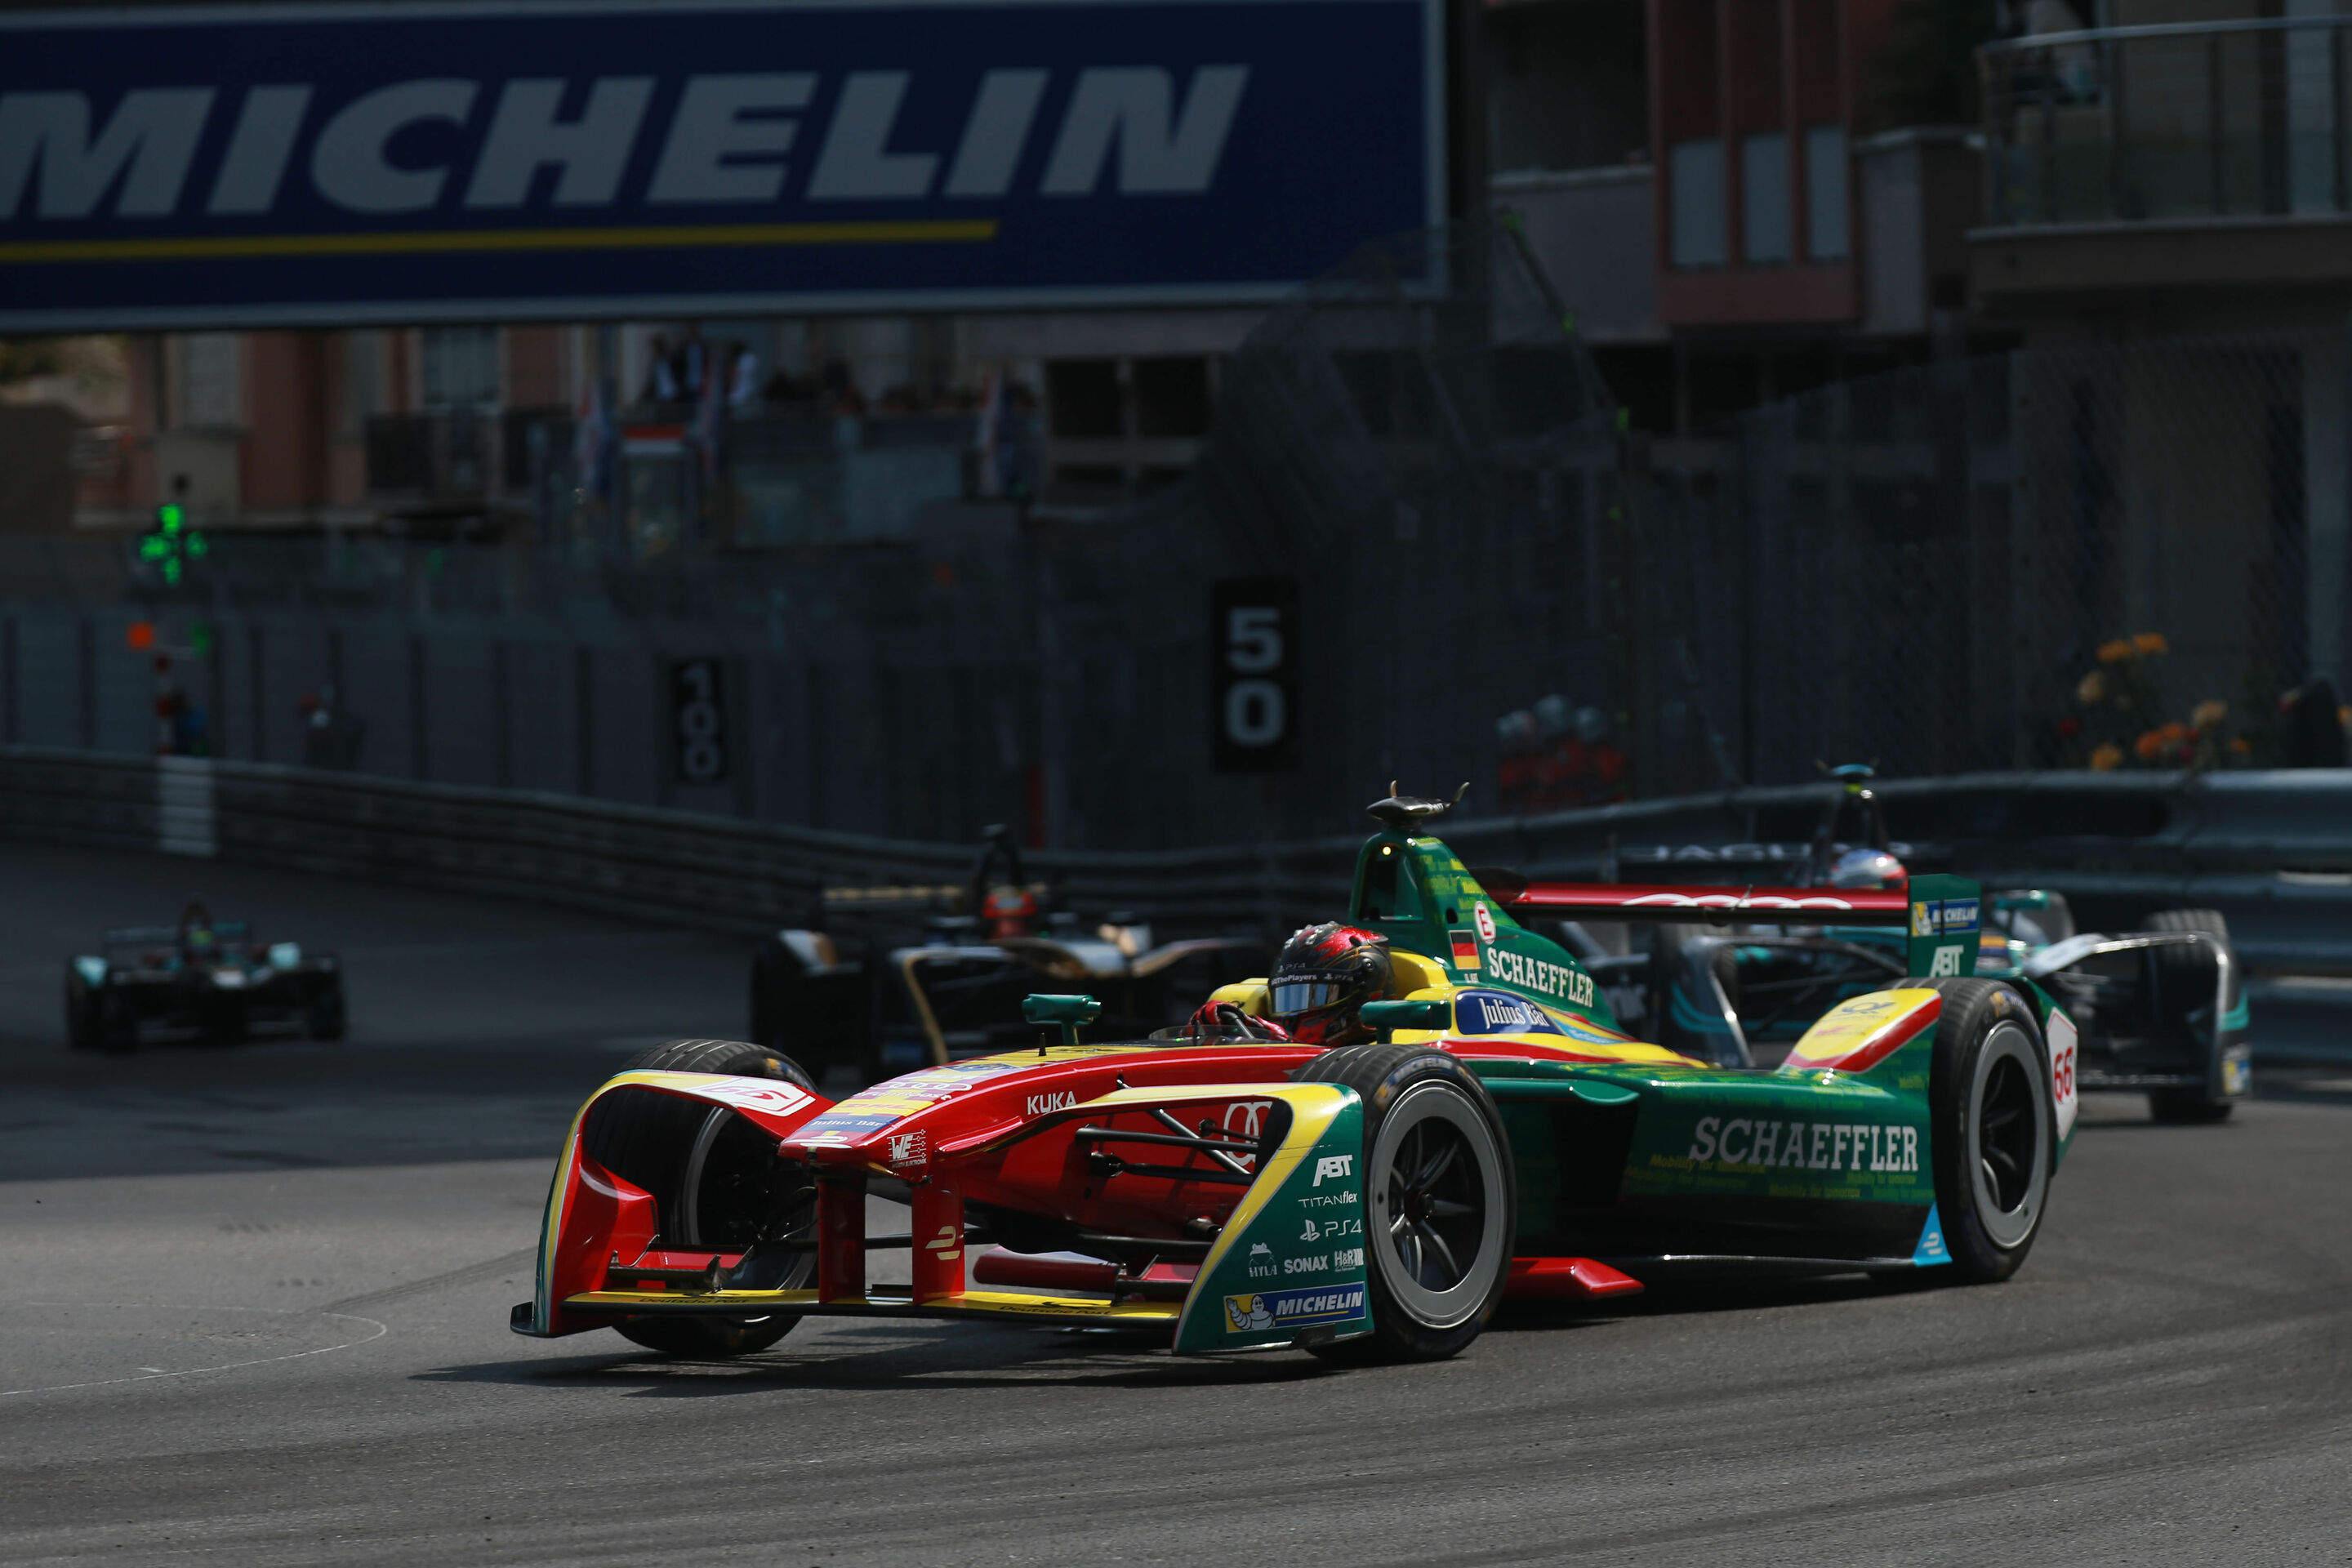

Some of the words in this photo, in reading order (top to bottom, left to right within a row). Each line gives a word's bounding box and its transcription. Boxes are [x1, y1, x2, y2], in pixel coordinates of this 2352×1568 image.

[0, 64, 1251, 219] MICHELIN
[1225, 605, 1284, 747] 50
[681, 663, 719, 776] 100
[1477, 909, 1492, 937] E
[1929, 944, 1964, 977] ABT
[1486, 947, 1593, 1008] SCHAEFFLER
[1479, 997, 1526, 1030] Julius
[2054, 1046, 2073, 1102] 66
[1027, 1090, 1077, 1115] KUKA
[856, 1120, 886, 1128] Bär
[890, 1134, 915, 1160] WE
[1687, 1116, 1918, 1172] SCHAEFFLER
[1312, 1154, 1353, 1187] ABT
[1650, 1154, 1695, 1173] Mobility
[1298, 1190, 1357, 1209] TITANflex
[1324, 1219, 1362, 1237] PS4
[1249, 1264, 1277, 1277] HYLA
[1284, 1255, 1329, 1274] SONAX
[1276, 1291, 1363, 1316] MICHELIN
